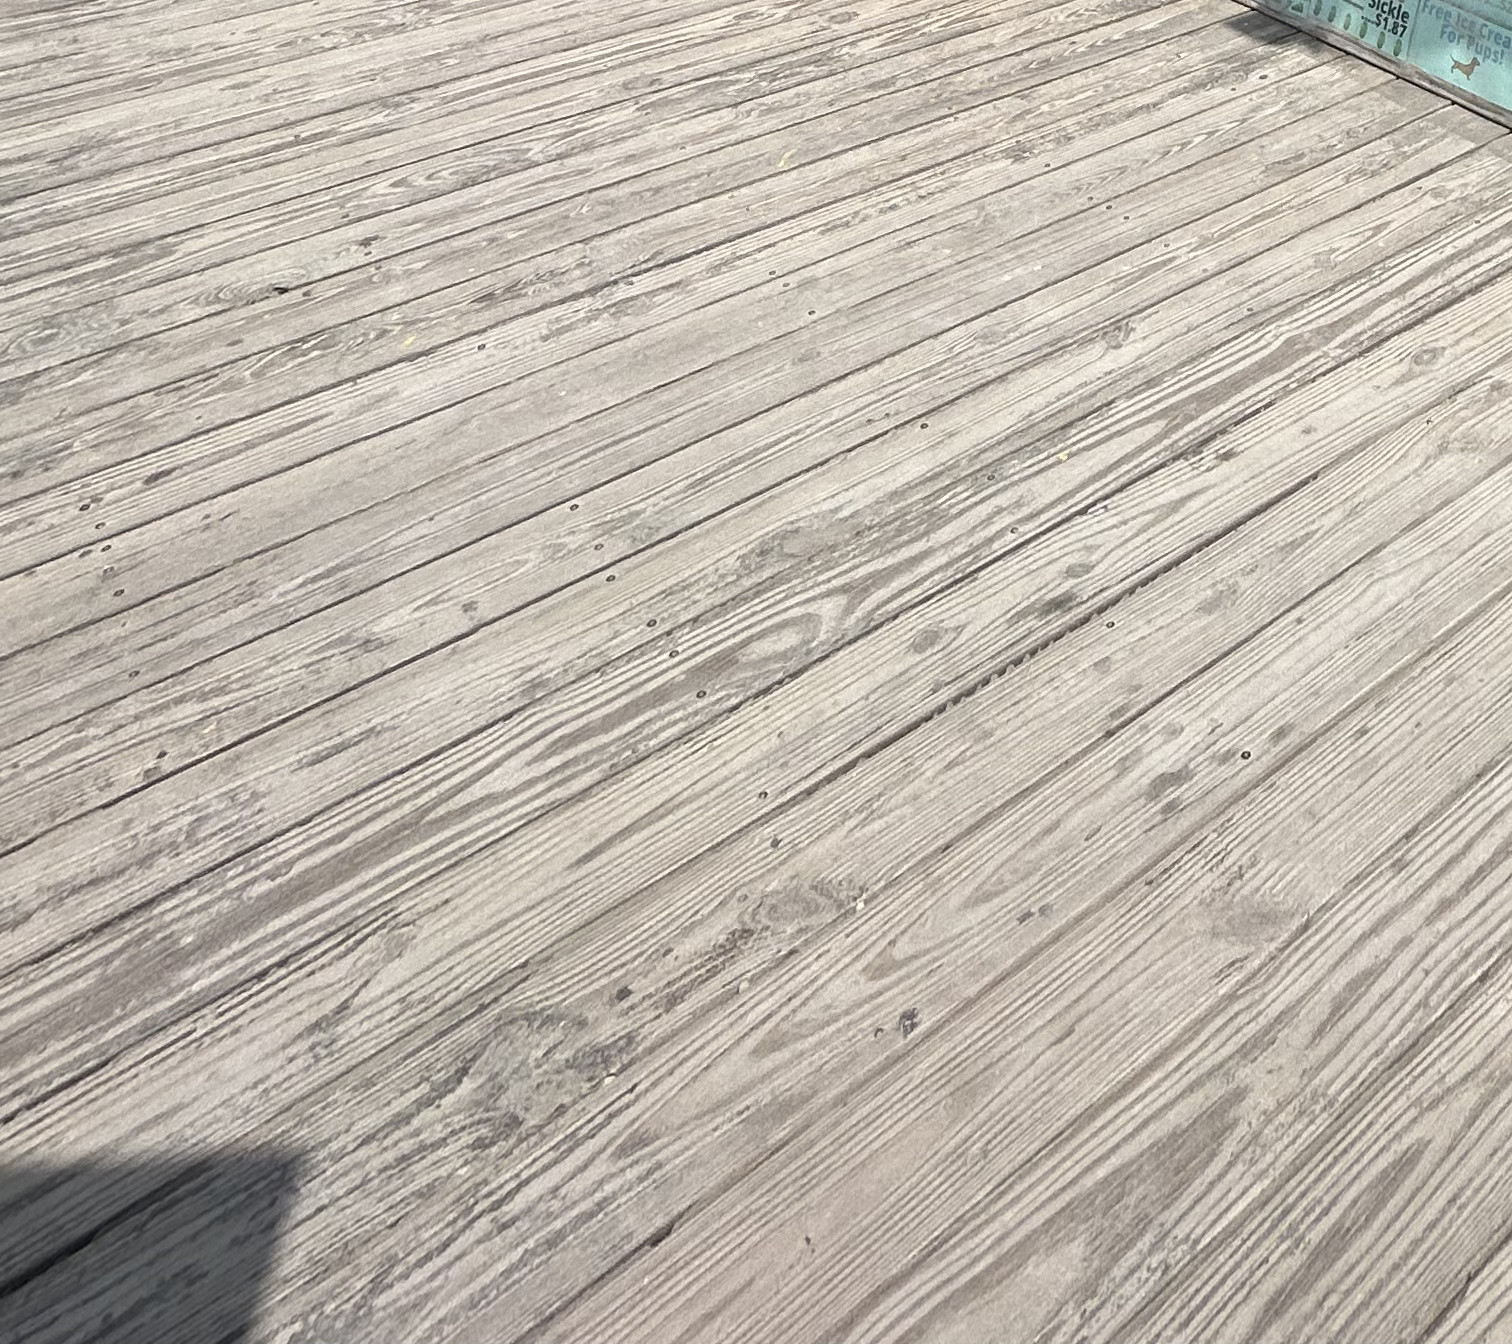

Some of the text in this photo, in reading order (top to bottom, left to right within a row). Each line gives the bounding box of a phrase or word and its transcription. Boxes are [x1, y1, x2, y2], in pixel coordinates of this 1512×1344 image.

[1455, 13, 1476, 30] Ice
[1440, 23, 1505, 65] For Pups!
